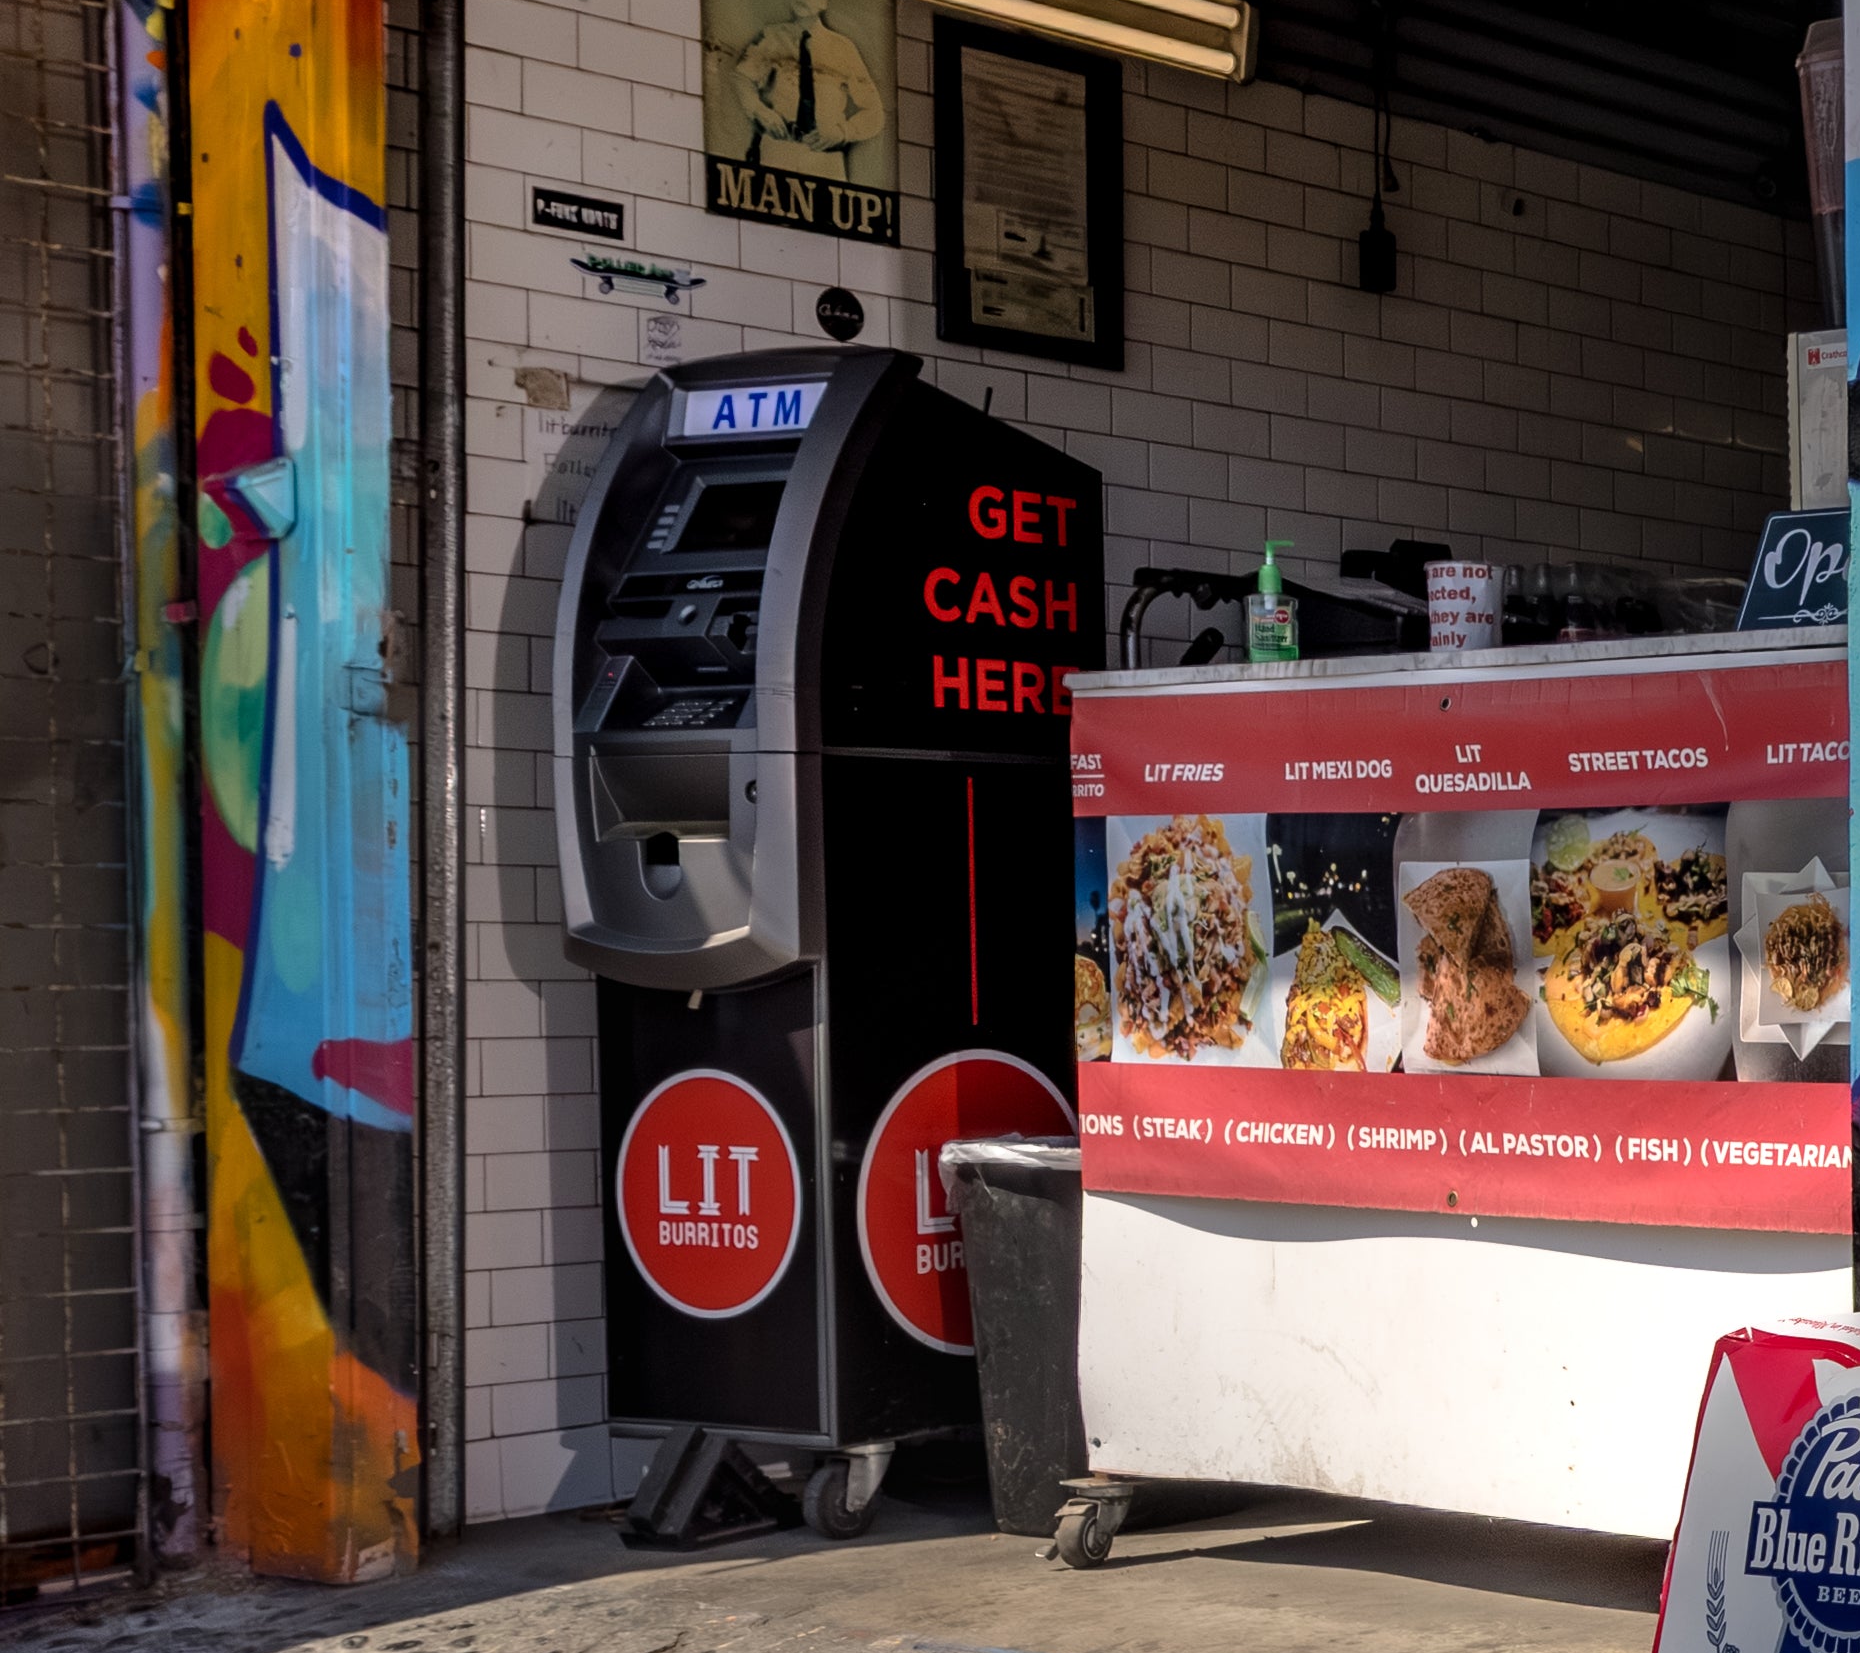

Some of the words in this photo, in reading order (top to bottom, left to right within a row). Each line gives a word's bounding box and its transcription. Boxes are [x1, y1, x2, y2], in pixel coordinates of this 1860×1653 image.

[717, 161, 816, 221] MAN
[828, 186, 894, 237] UP!
[712, 390, 801, 430] ATM
[968, 486, 1076, 546] GET
[1462, 564, 1493, 579] not
[923, 567, 1077, 632] CASH
[1465, 612, 1494, 624] are
[932, 655, 1077, 715] HERE
[1454, 744, 1482, 764] LIT
[1568, 750, 1640, 774] STREET
[1641, 747, 1709, 771] TACOS
[1766, 743, 1797, 764] LIT
[1144, 763, 1170, 783] LIT
[1172, 763, 1224, 783] FRIES
[1284, 761, 1309, 781] LIT
[1311, 760, 1353, 780] MEXI
[1355, 759, 1393, 780] DOG
[1415, 772, 1532, 794] QUESADILLA
[1079, 1113, 1124, 1136] IONS
[658, 1144, 759, 1216] LIT
[658, 1221, 759, 1249] BURRITOS
[1750, 1507, 1827, 1574] Blue
